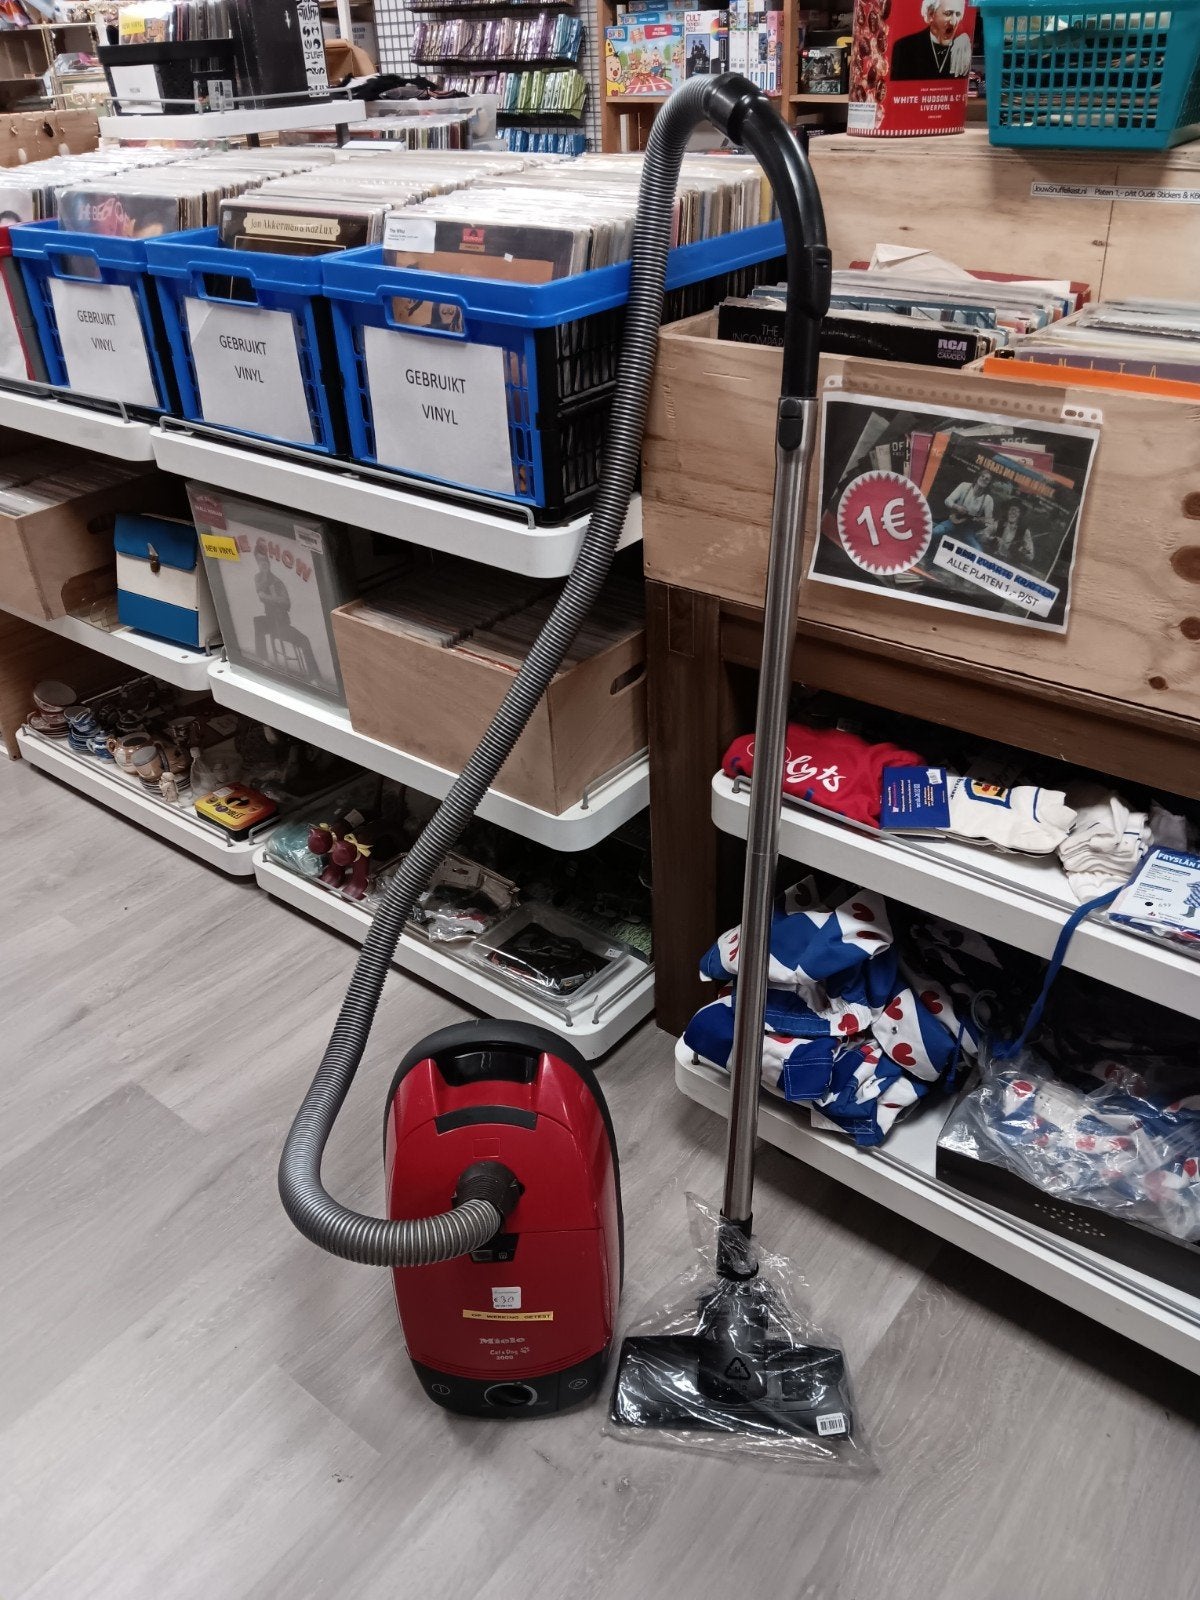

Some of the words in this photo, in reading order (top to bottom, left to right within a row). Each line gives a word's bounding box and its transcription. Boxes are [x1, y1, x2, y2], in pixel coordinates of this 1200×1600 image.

[893, 96, 919, 104] WHITE
[922, 95, 949, 103] HUDSON
[1138, 190, 1156, 198] Oude
[1156, 191, 1181, 199] Stickers
[77, 309, 116, 326] GEBRUIKT
[761, 324, 779, 337] THE
[90, 337, 116, 352] VINYL
[219, 334, 267, 356] GEBRUIKT
[937, 338, 968, 351] RCA
[234, 365, 265, 384] VINYL
[405, 368, 467, 394] GEBRUIKT
[421, 403, 459, 426] VINYL
[856, 497, 913, 546] 1€
[205, 544, 219, 554] NEW
[219, 546, 236, 556] VINYL
[946, 557, 969, 573] ALLE
[969, 568, 1004, 591] PLATEN
[1017, 592, 1040, 608] P/ST
